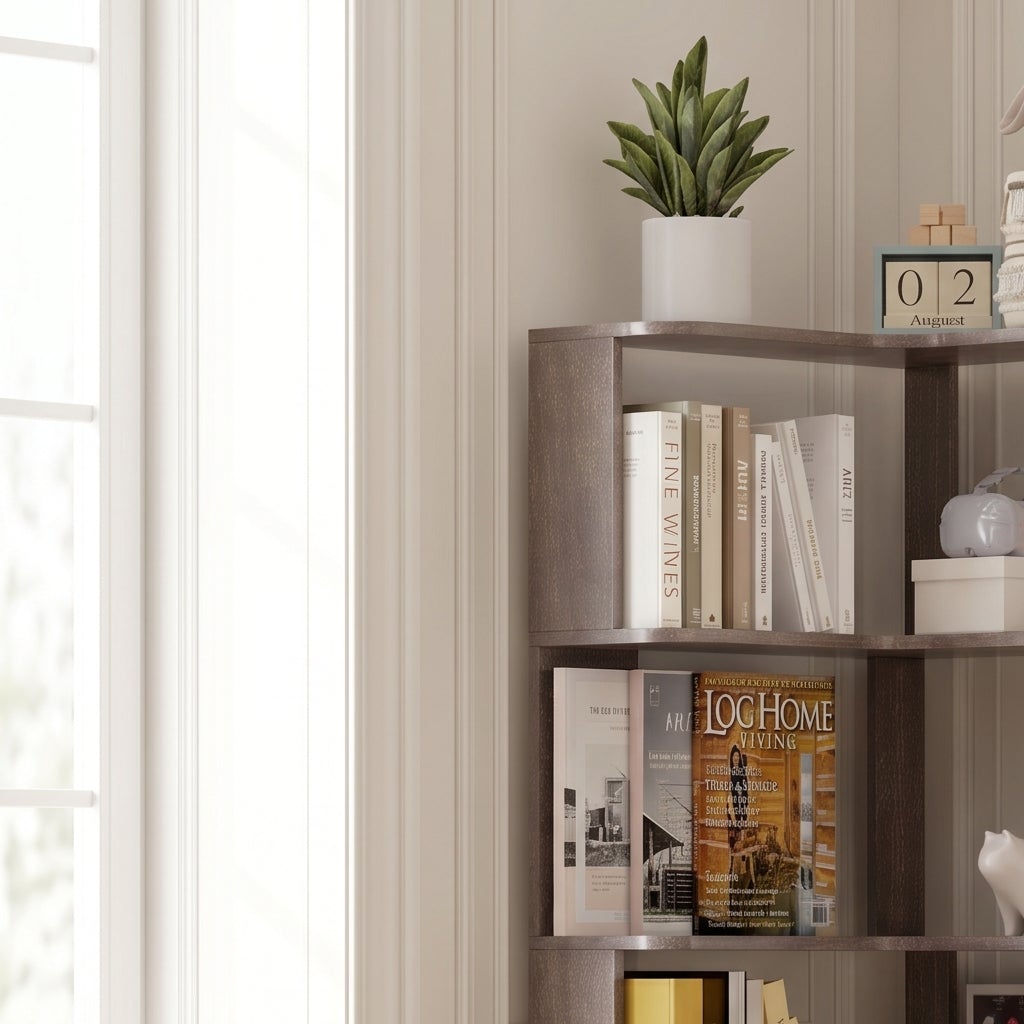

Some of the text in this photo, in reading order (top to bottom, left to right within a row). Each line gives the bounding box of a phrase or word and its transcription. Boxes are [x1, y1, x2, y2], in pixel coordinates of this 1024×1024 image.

[910, 314, 965, 328] August
[663, 442, 680, 598] FINE WINES
